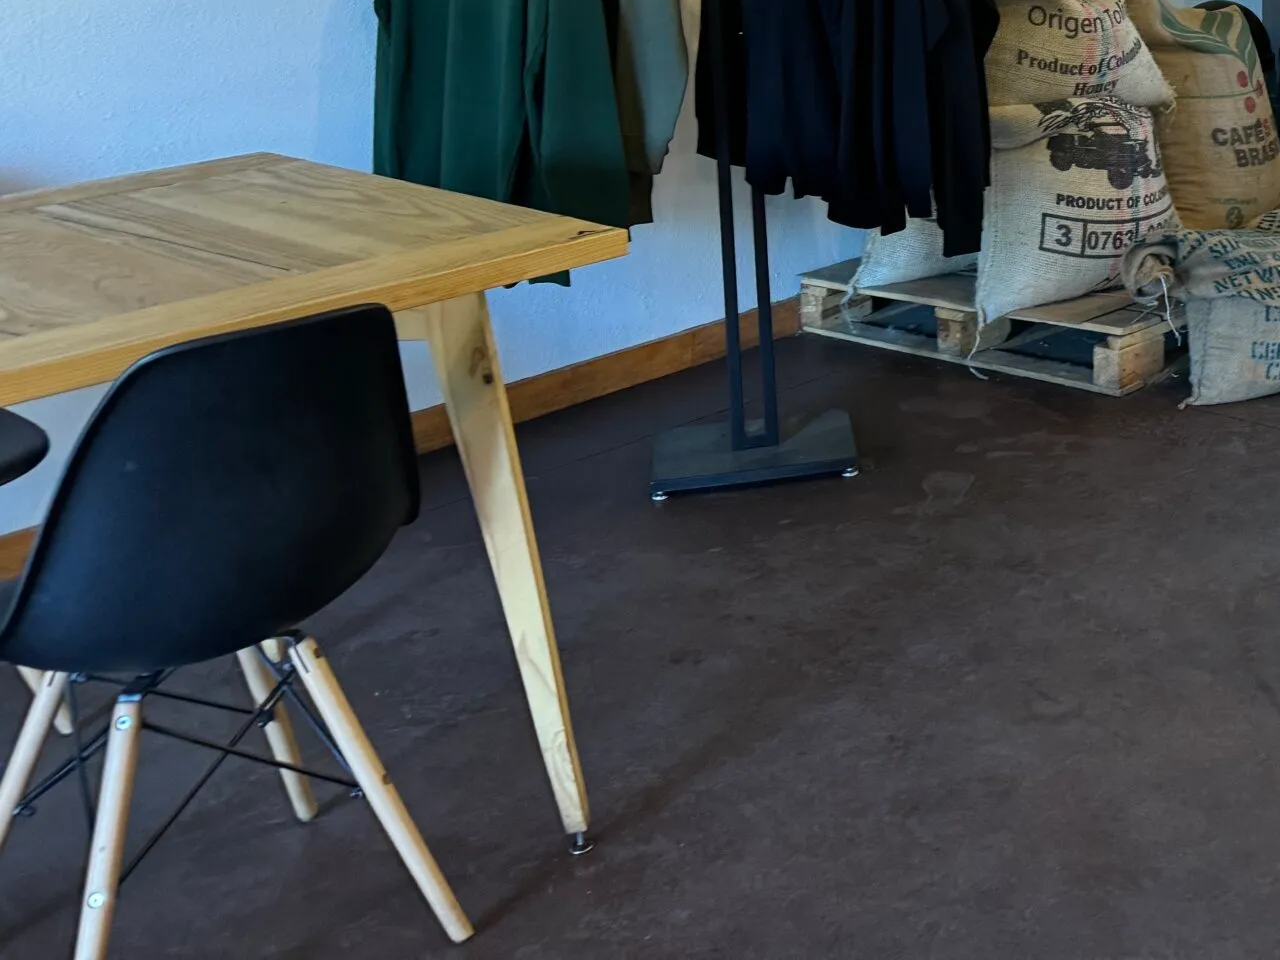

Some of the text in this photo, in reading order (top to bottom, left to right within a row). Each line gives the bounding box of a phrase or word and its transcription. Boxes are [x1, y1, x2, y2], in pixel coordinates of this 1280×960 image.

[1028, 5, 1106, 39] Origen
[1016, 48, 1088, 76] Product
[1087, 56, 1106, 77] of
[1073, 78, 1120, 97] Honey
[1055, 193, 1123, 211] PRODUCT
[1126, 195, 1141, 209] OF
[1054, 223, 1134, 251] 3 0763
[1213, 270, 1253, 294] NET
